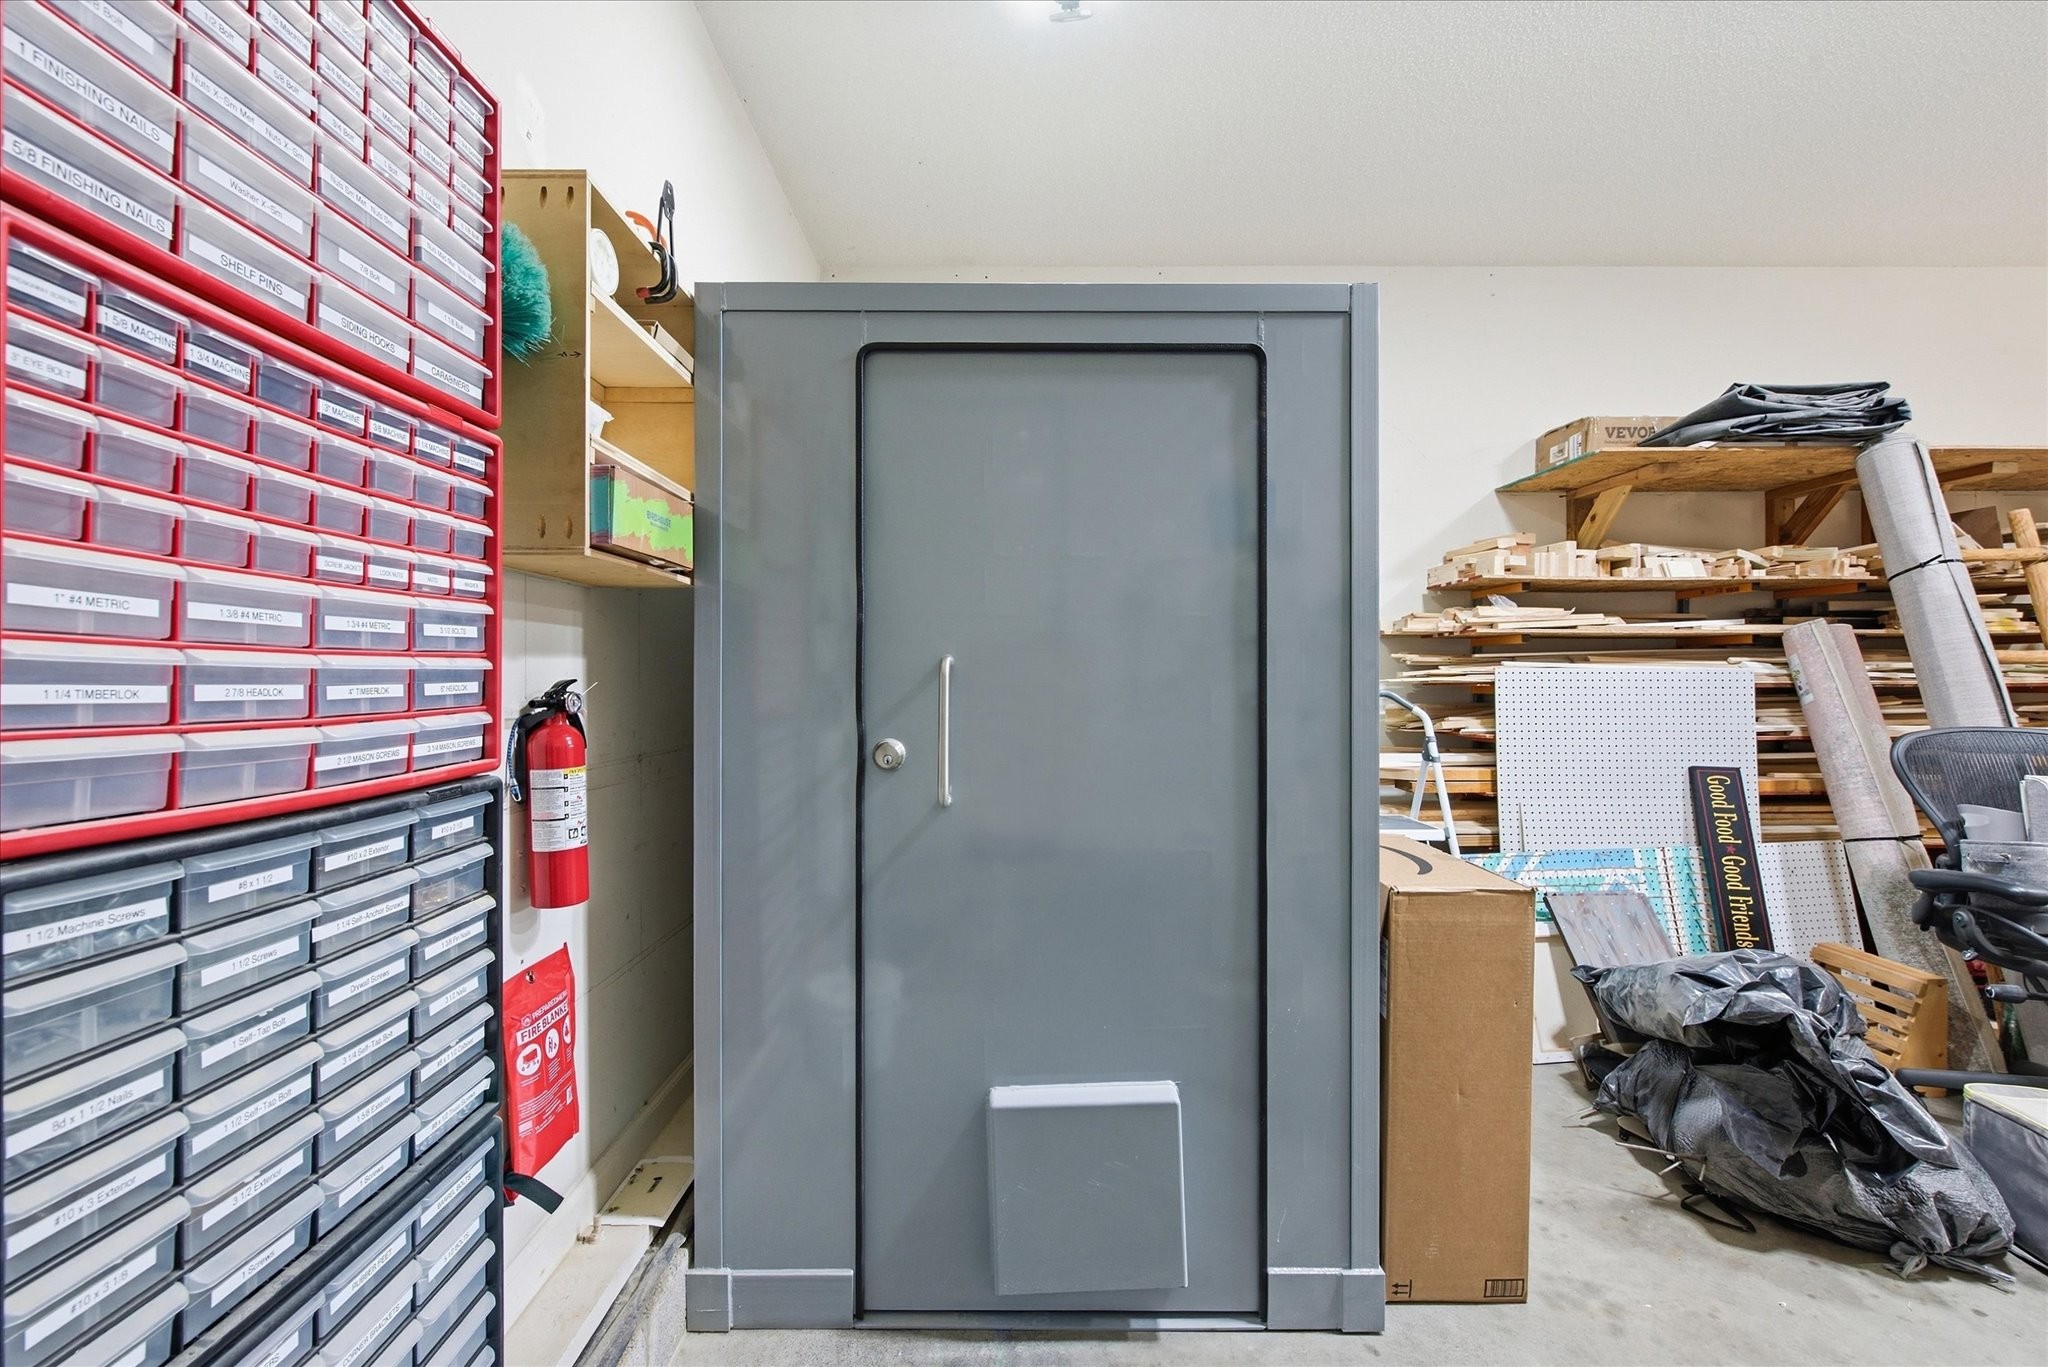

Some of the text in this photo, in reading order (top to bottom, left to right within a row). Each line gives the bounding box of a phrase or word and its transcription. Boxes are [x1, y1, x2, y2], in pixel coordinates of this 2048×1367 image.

[19, 41, 161, 143] 1 FINISHING NAILS
[190, 72, 211, 93] Nuts
[12, 139, 166, 234] 5/8 FINISHING NAILS
[230, 178, 260, 205] Washer
[220, 254, 284, 297] SHELF PINS
[112, 313, 128, 331] 5/8
[130, 320, 178, 352] MACHINE
[340, 316, 397, 354] SIDING HOOKS
[23, 354, 44, 372] EYE
[46, 362, 72, 380] BOLT
[196, 350, 211, 366] 3/4
[211, 356, 250, 382] MACHINE
[431, 366, 470, 394] CARABINERS
[332, 406, 361, 425] MACHINE
[68, 595, 82, 606] #4
[85, 598, 130, 610] METRIC
[226, 610, 239, 618] 3/8
[240, 611, 250, 620] #4
[252, 612, 282, 622] METRIC
[370, 622, 391, 630] METRIC
[44, 689, 140, 700] 1 1/4 TIMBERLOK
[225, 688, 284, 698] 2 7/8 HEADLOK
[356, 688, 390, 696] TIMBERLOK
[352, 752, 376, 763] MASON
[376, 750, 400, 760] SCREWS
[1706, 775, 1760, 950] Good Food Good Friends
[238, 880, 248, 890] #8
[262, 874, 274, 884] 1/2
[26, 906, 146, 944] 1 1/2 Machine Screws
[351, 908, 385, 926] Self-Anchor
[384, 901, 404, 912] Screws
[238, 958, 250, 970] 1/2
[251, 948, 278, 964] Screws
[350, 970, 390, 994] Drywall Screws
[238, 1022, 270, 1047] Self-Tap
[272, 1016, 286, 1031] Bolt
[382, 1030, 394, 1042] Bolt
[521, 1004, 568, 1042] FIRE BLANKE
[69, 1116, 76, 1124] x
[90, 1101, 105, 1116] 1/2
[108, 1089, 134, 1107] Nails
[230, 1116, 242, 1128] 1/2
[244, 1096, 277, 1122] Self-Tap
[278, 1088, 293, 1102] Bolt
[241, 1187, 252, 1201] 1/2
[254, 1168, 283, 1193] Exterior
[364, 1164, 384, 1185] Screws
[54, 1176, 137, 1227] #10 x 3 Exterior
[248, 1250, 276, 1274] Screws
[70, 1270, 129, 1314] #10 x 3 1/8
[369, 1302, 400, 1339] BRACKETS
